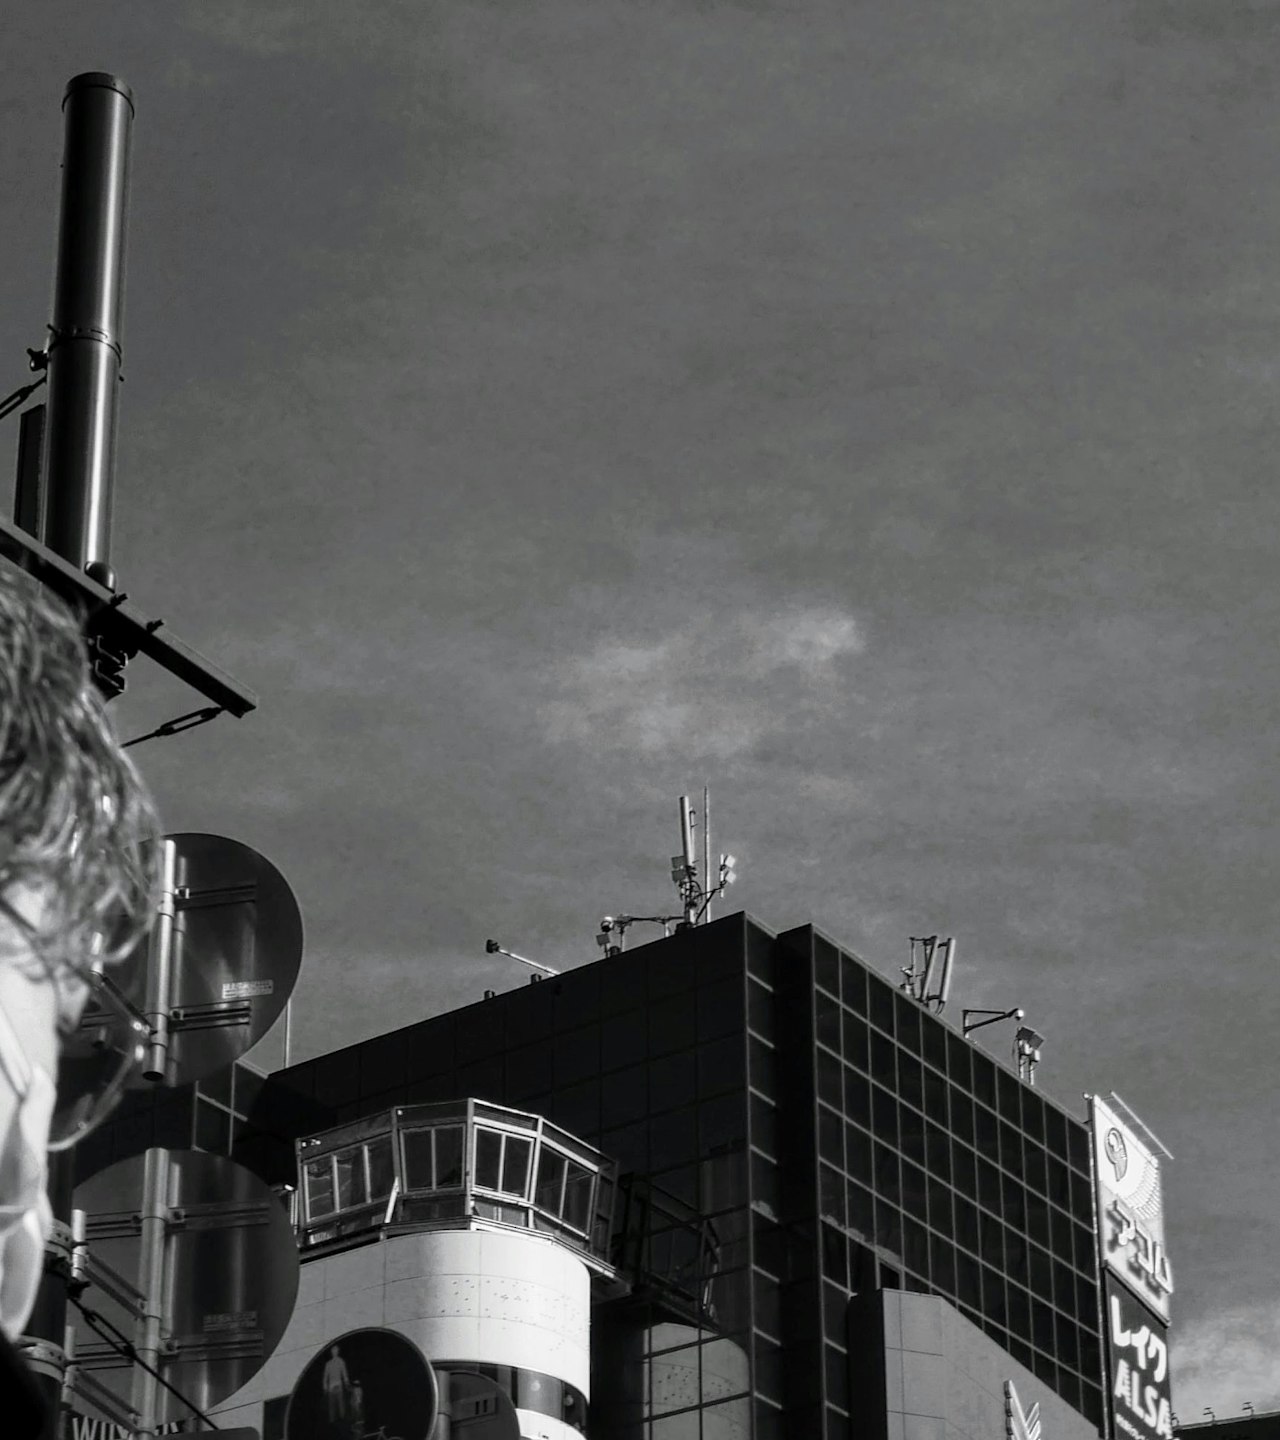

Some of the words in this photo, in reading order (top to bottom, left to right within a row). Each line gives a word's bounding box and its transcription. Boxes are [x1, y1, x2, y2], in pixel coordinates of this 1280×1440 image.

[1110, 1294, 1167, 1384] レイク
[1113, 1357, 1173, 1440] ALSA
